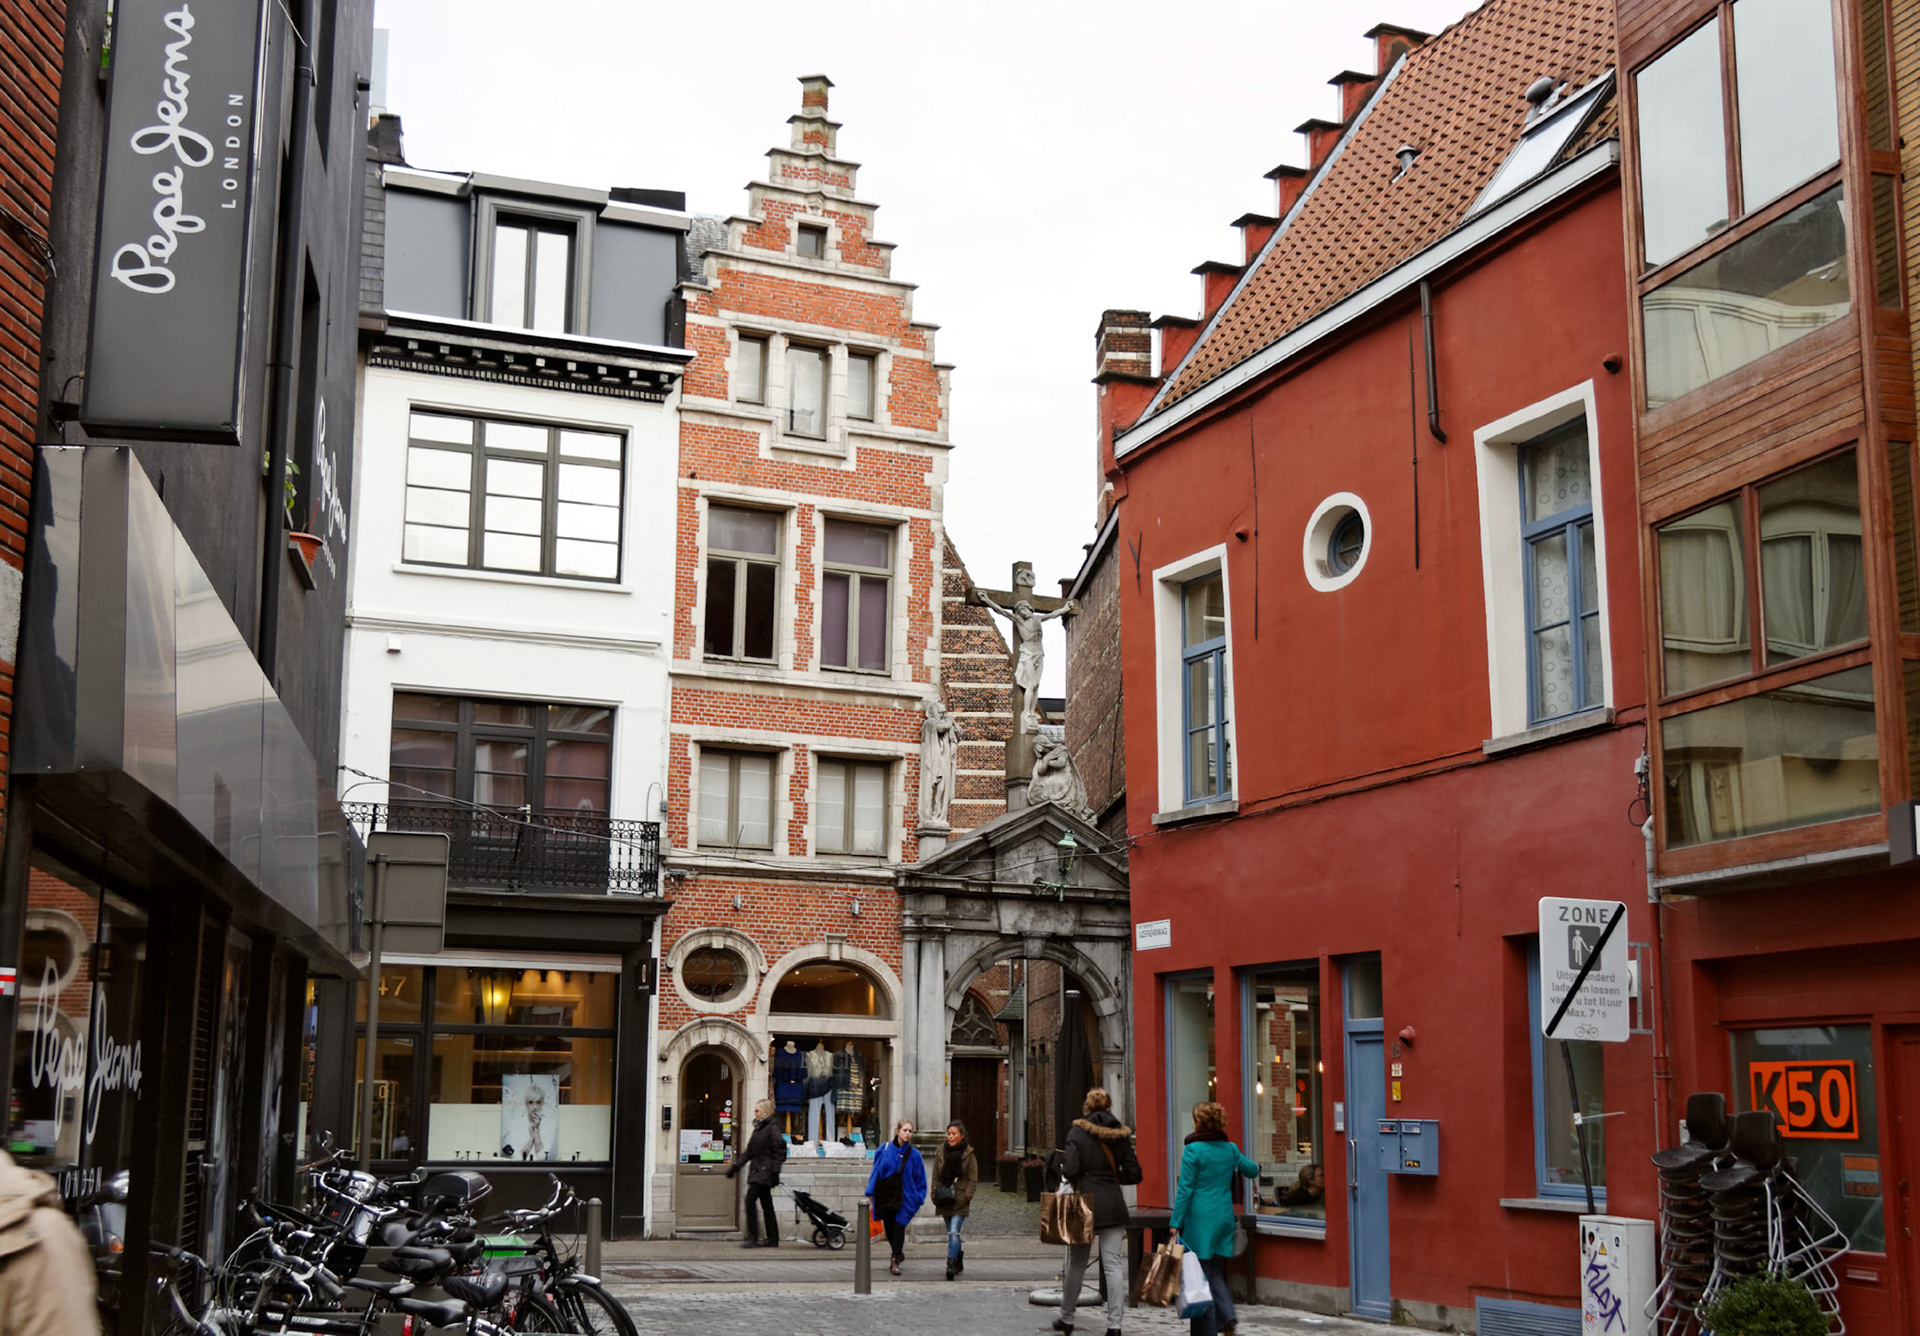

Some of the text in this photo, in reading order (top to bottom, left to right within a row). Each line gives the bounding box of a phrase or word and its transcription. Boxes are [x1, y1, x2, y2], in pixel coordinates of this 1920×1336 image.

[111, 3, 214, 294] Pepe Jeans
[221, 94, 244, 209] LONDON
[1559, 905, 1609, 924] ZONE
[1591, 984, 1620, 995] lossen
[1584, 996, 1597, 1006] tot
[1607, 999, 1622, 1007] uur
[1566, 1007, 1587, 1018] Max.
[31, 955, 142, 1145] Pepe Jeans
[1390, 1042, 1401, 1058] 18
[1754, 1069, 1850, 1129] K50
